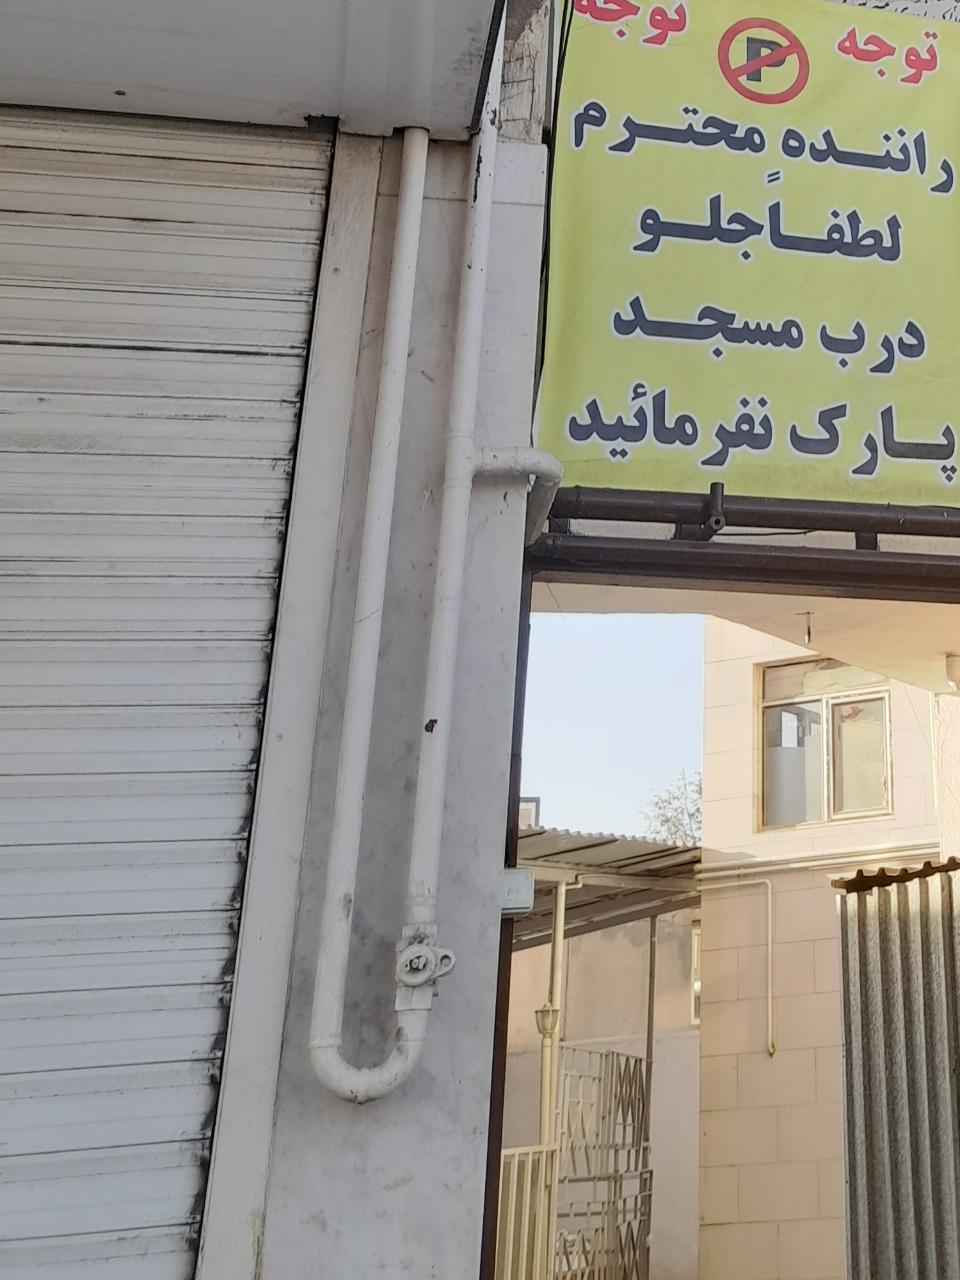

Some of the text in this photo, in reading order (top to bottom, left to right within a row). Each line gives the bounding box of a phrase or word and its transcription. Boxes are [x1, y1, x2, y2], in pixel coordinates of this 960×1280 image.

[837, 27, 940, 84] توجه
[573, 100, 956, 193] راننده محترم
[633, 195, 764, 261] جلو
[613, 296, 926, 373] درب مسجد
[568, 382, 957, 483] پارک نفرمائید
